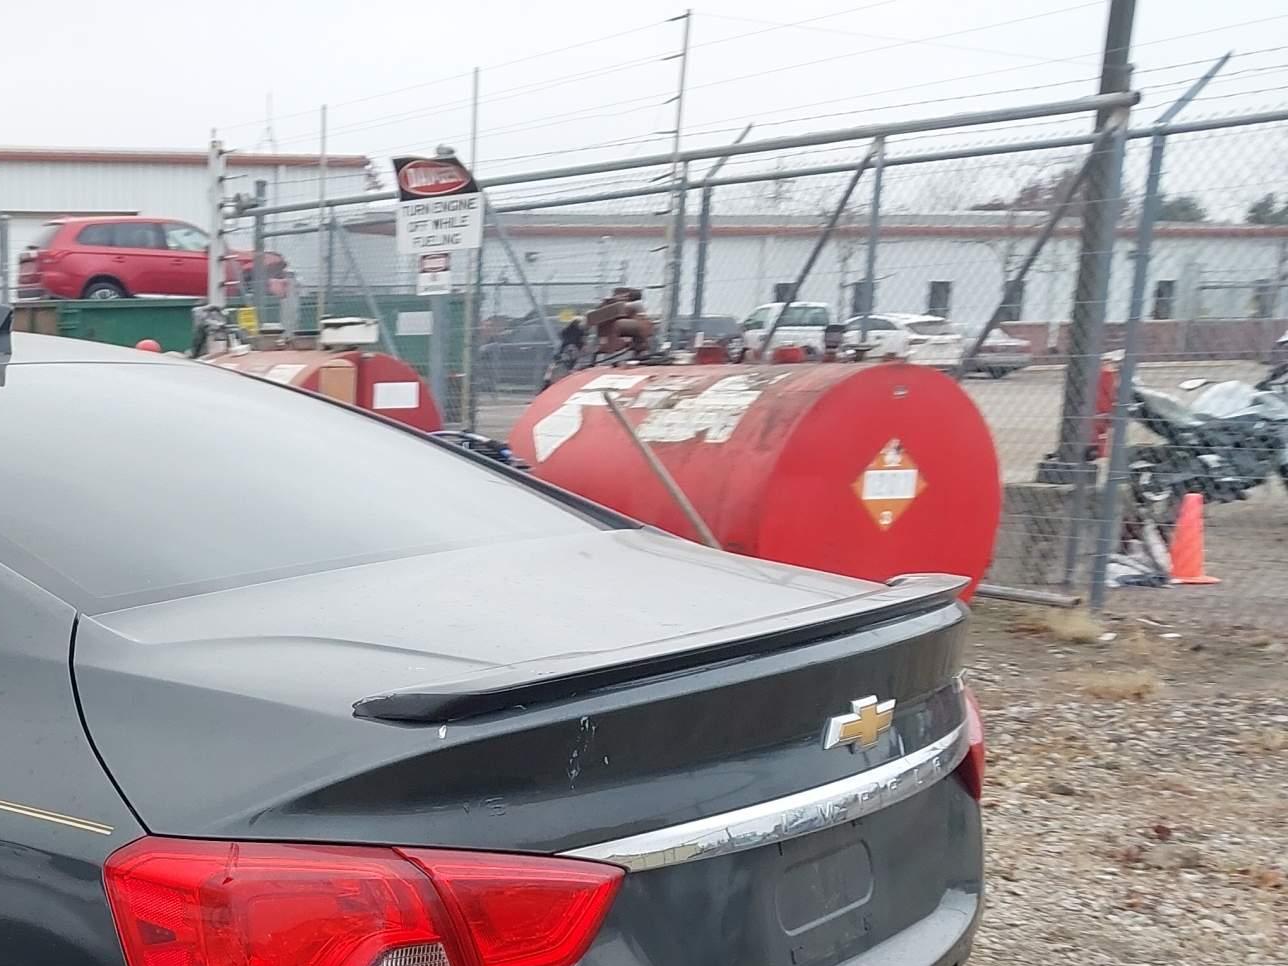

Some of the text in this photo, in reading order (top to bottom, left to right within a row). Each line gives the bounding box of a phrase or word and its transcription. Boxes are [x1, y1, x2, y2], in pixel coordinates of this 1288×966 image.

[402, 197, 478, 217] TURN ENGINE
[407, 215, 469, 233] OFF WHILE
[412, 232, 462, 248] FUELING
